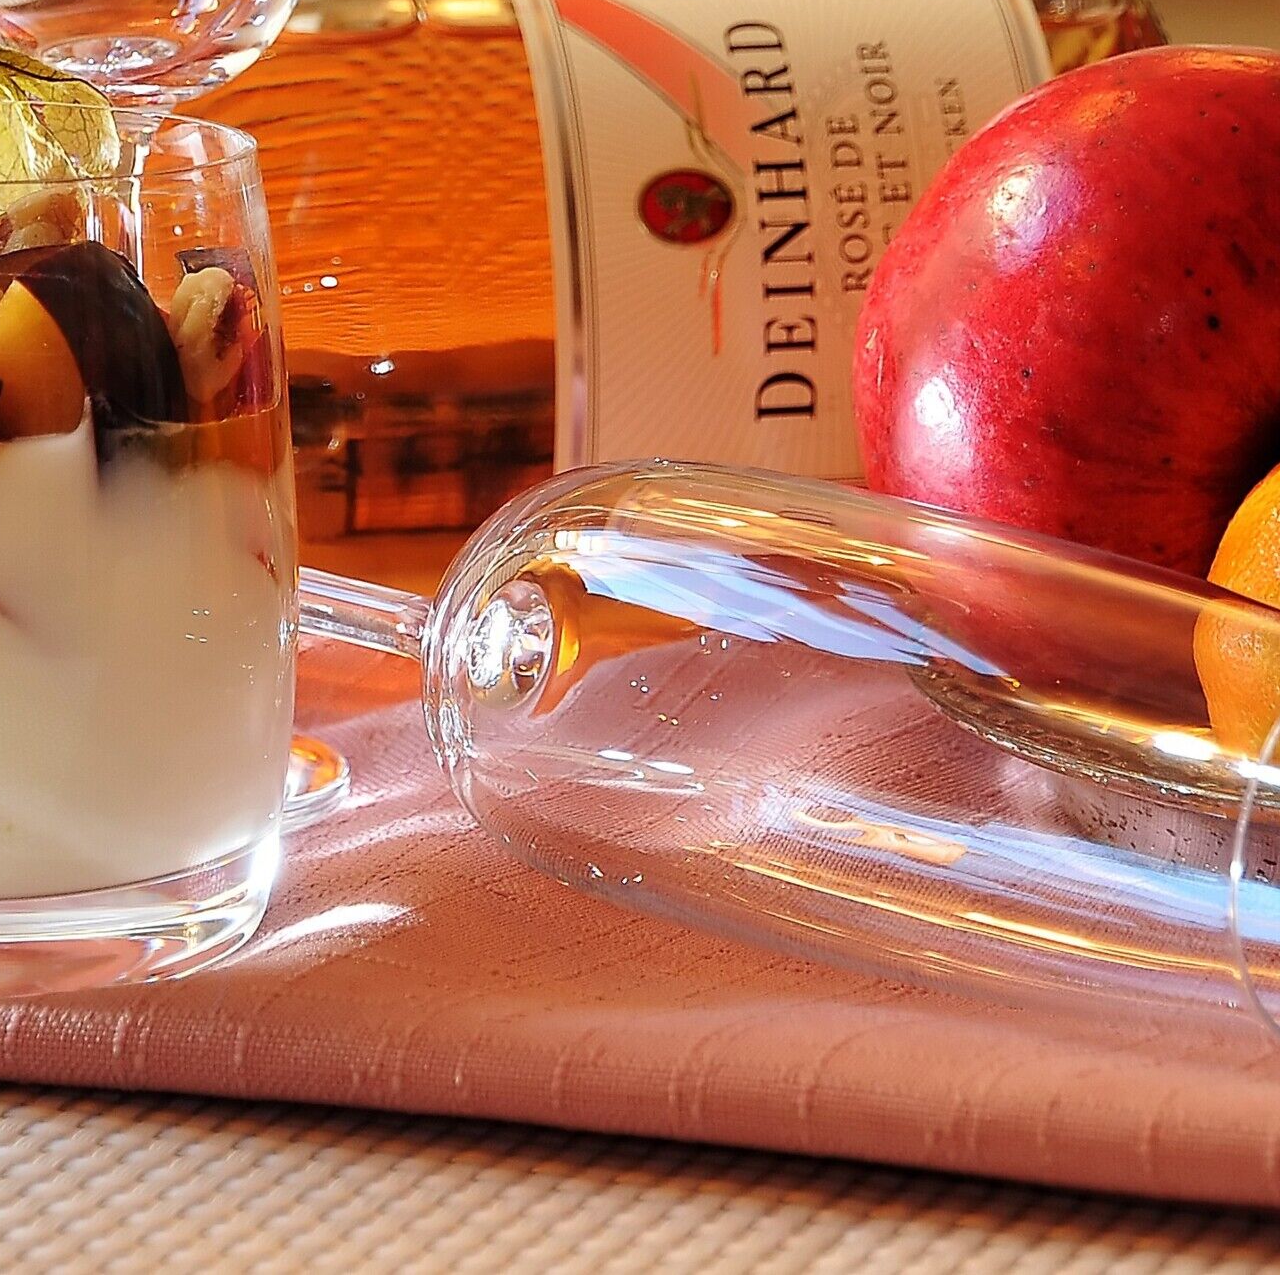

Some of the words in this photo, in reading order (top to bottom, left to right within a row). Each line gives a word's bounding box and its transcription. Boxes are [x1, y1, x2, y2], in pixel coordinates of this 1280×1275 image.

[855, 40, 904, 135] NOIR
[826, 113, 864, 168] DE
[876, 153, 913, 205] ET
[723, 21, 817, 422] DEINHARD
[830, 181, 873, 293] ROSÉ
